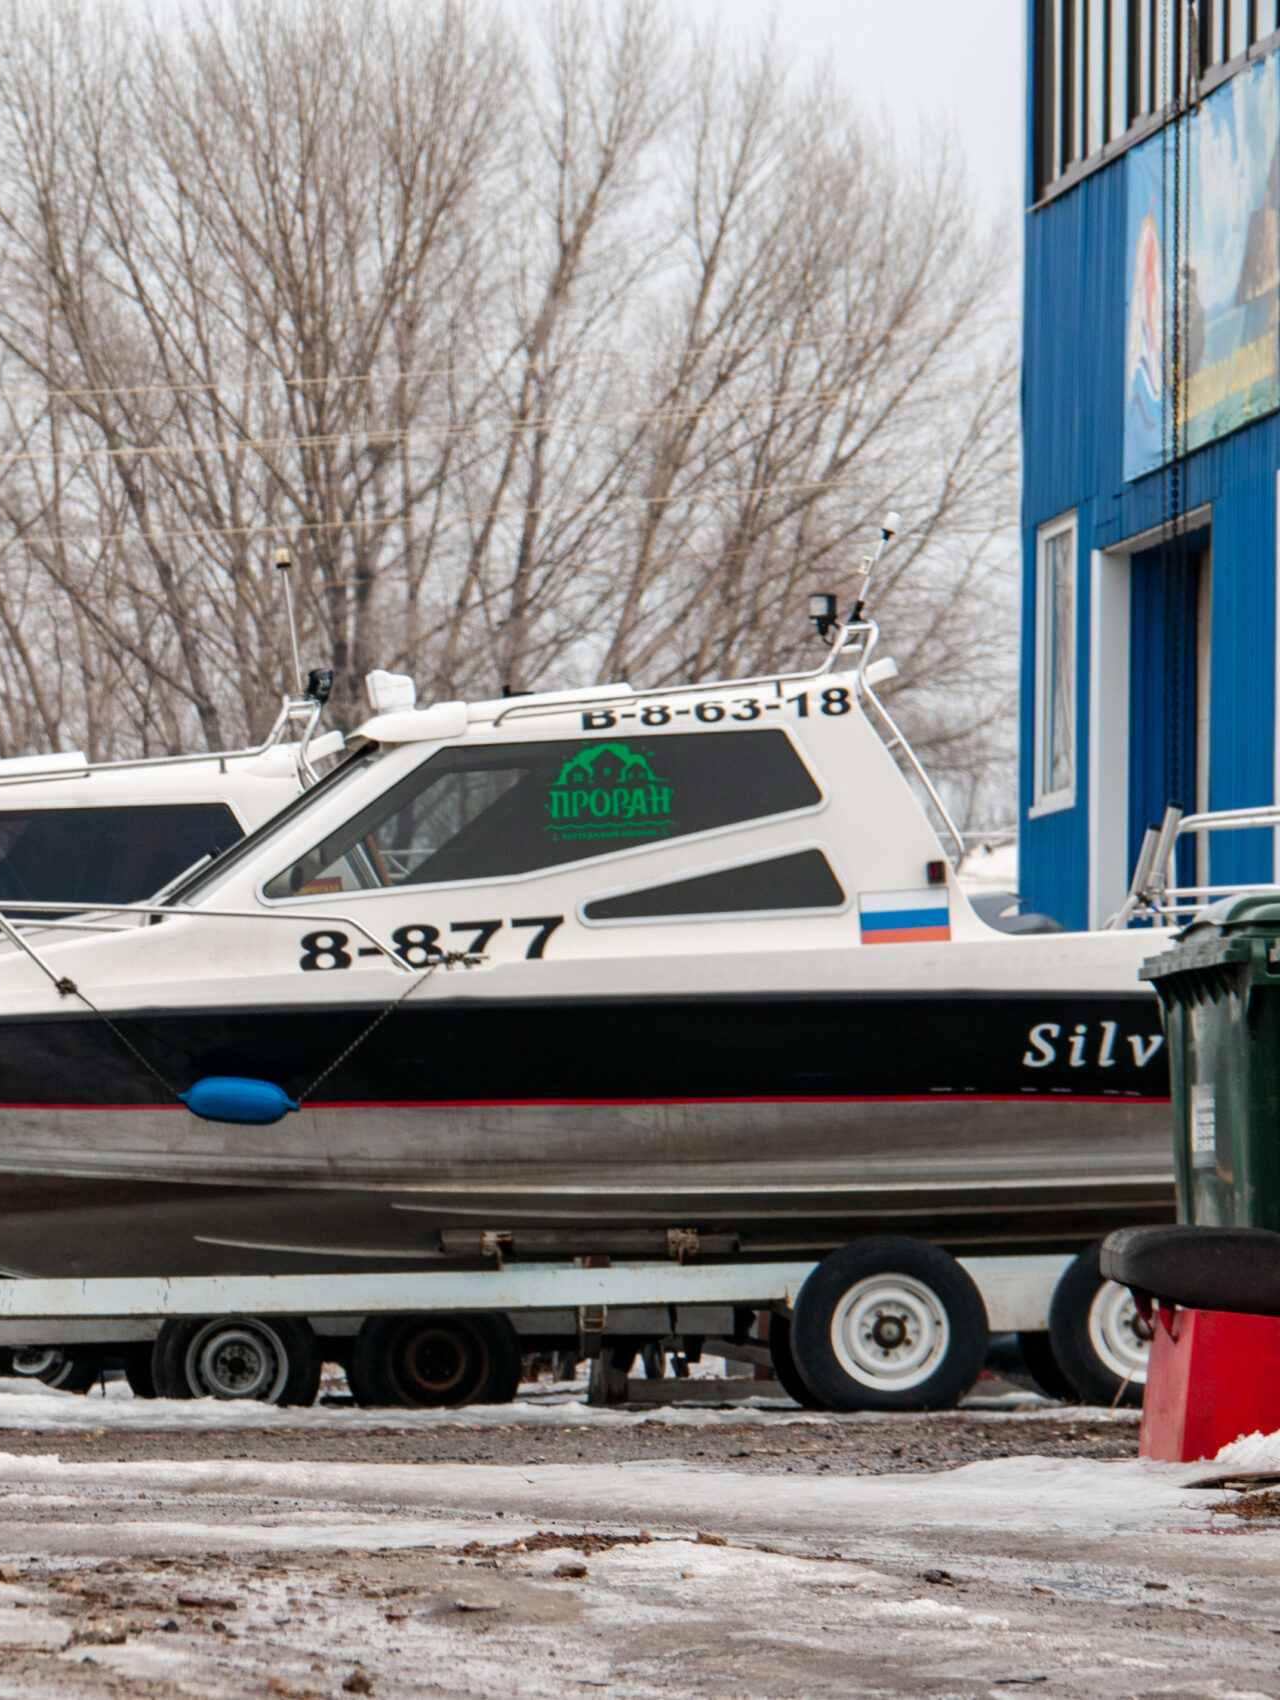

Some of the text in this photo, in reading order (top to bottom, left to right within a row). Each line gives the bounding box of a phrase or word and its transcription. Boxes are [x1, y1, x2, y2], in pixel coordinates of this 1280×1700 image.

[549, 783, 672, 820] ПРОРАН
[299, 915, 565, 972] 8-877
[1022, 1020, 1165, 1068] Silv
